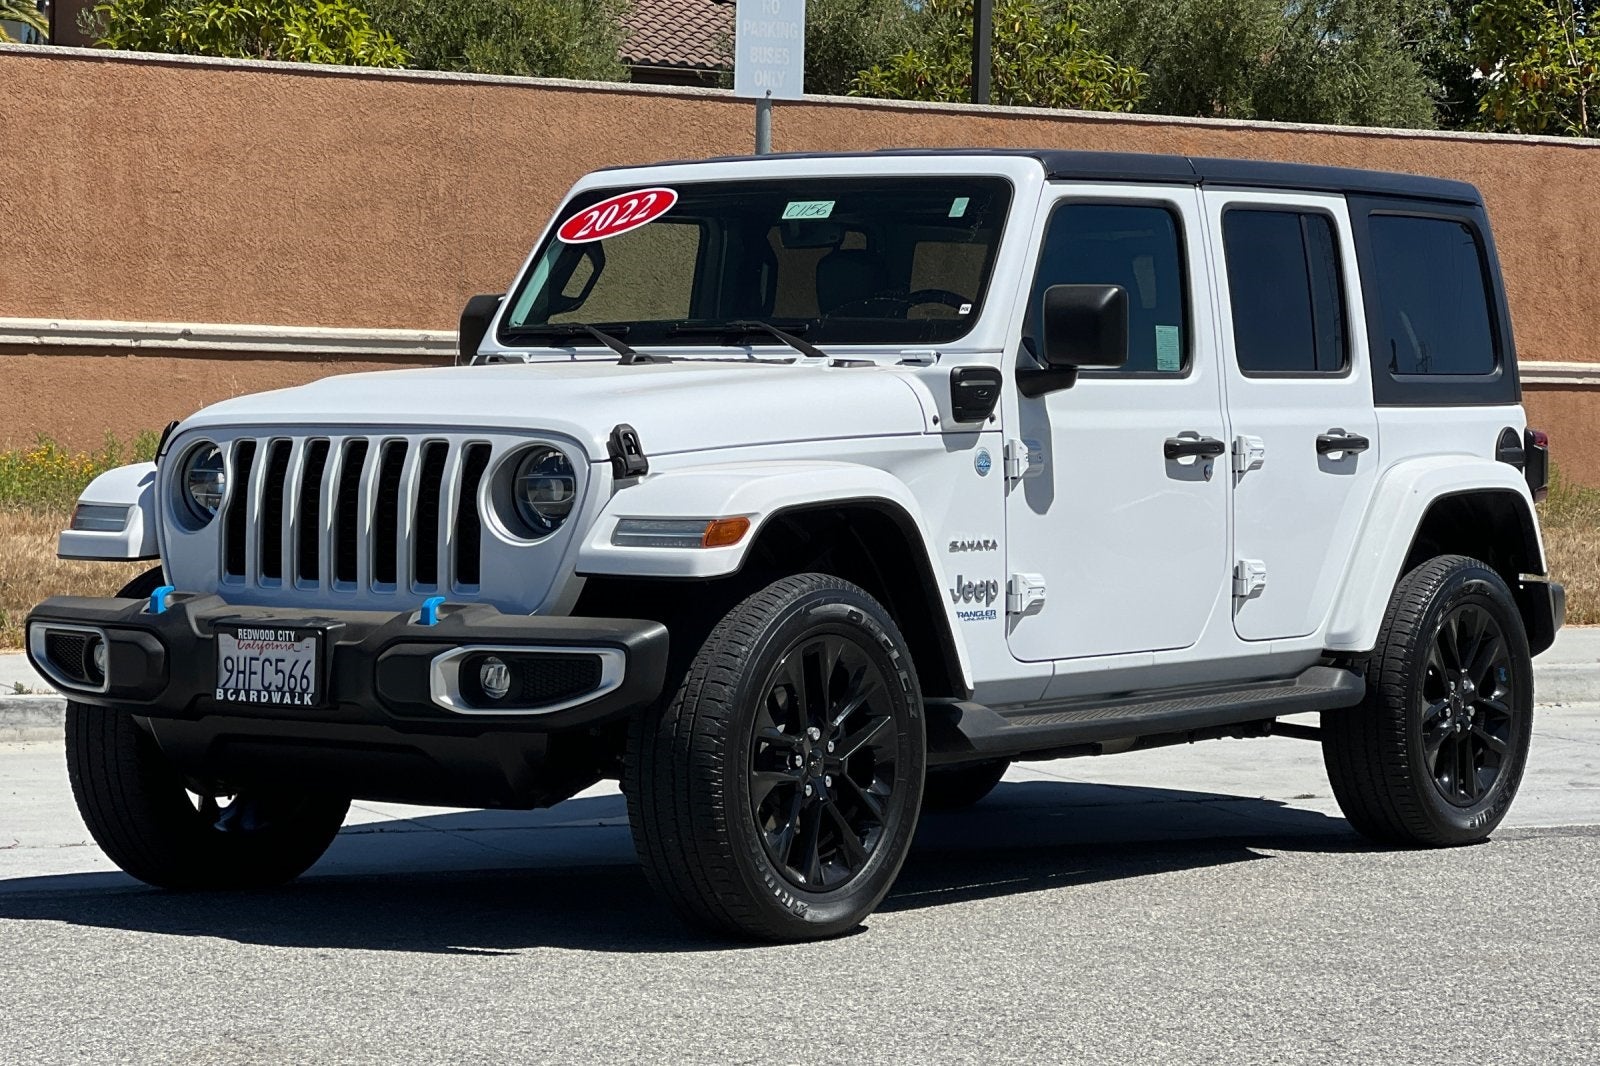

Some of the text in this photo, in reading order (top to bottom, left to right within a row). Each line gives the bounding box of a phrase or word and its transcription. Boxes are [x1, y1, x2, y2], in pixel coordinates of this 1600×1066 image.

[743, 19, 798, 39] PARKING
[750, 46, 790, 65] BUSES
[754, 70, 785, 88] ONLY
[572, 192, 658, 239] 2022
[949, 540, 998, 552] SAHARA
[949, 574, 998, 607] Jeep
[237, 628, 295, 642] REDWOOD CITY
[237, 639, 301, 656] California
[221, 655, 312, 692] 9HFC566
[216, 688, 313, 705] BOARDWALK
